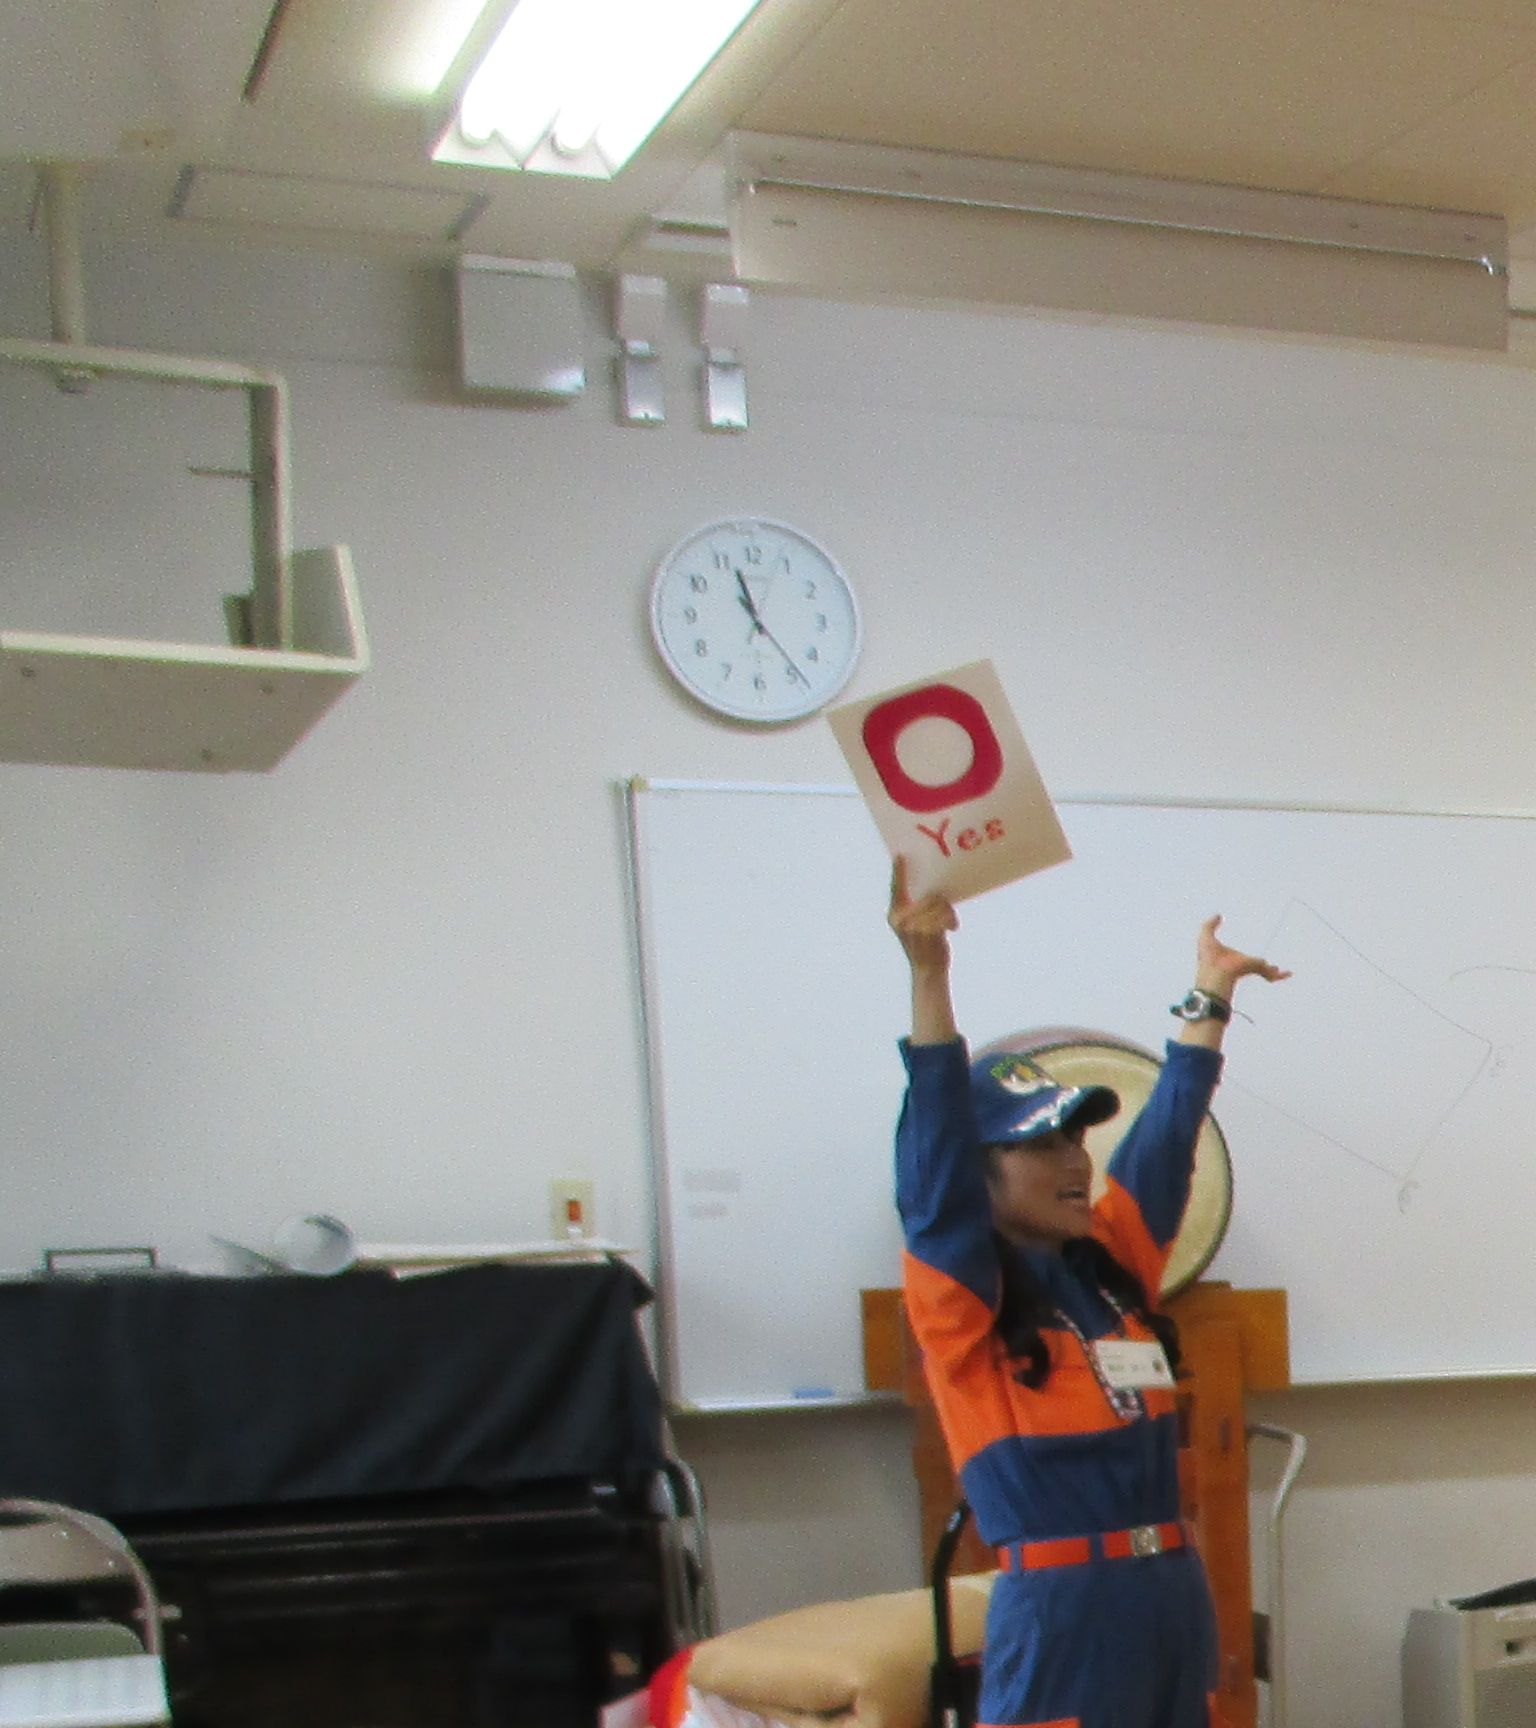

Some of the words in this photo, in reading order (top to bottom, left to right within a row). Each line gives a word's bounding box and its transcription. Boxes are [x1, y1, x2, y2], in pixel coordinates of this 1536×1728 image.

[713, 552, 730, 570] 11
[744, 545, 763, 565] 12
[690, 573, 708, 594] 10
[804, 579, 817, 600] 2
[683, 606, 698, 625] 9
[816, 612, 828, 633] 3
[694, 638, 709, 658] 8
[806, 646, 819, 663] 4
[721, 662, 733, 682] 7
[785, 664, 799, 686] 5
[752, 673, 767, 692] 6
[916, 818, 1006, 858] Yes
